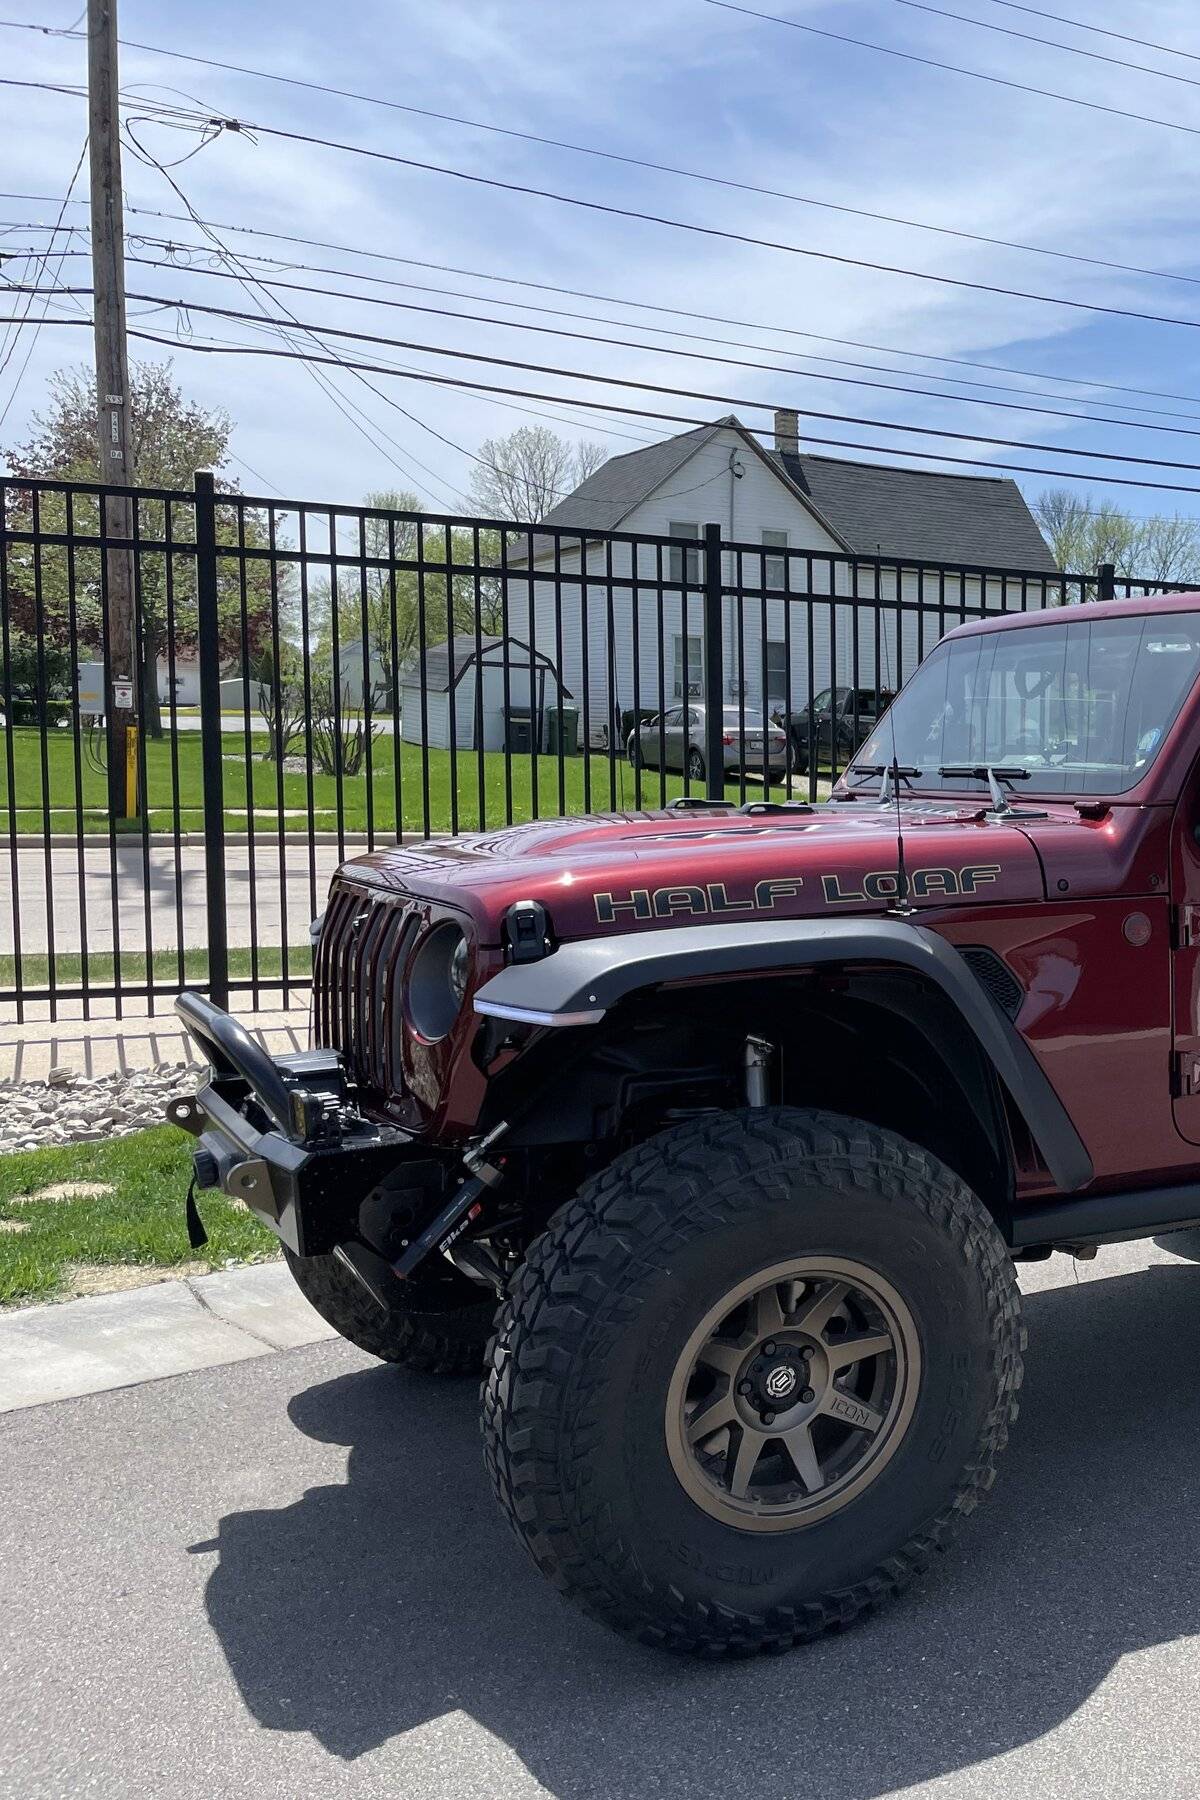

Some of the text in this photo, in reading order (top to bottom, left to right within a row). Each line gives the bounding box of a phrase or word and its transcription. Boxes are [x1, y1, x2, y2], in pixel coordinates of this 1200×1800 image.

[595, 865, 1002, 923] HALF LOAF
[831, 1397, 870, 1425] ICON
